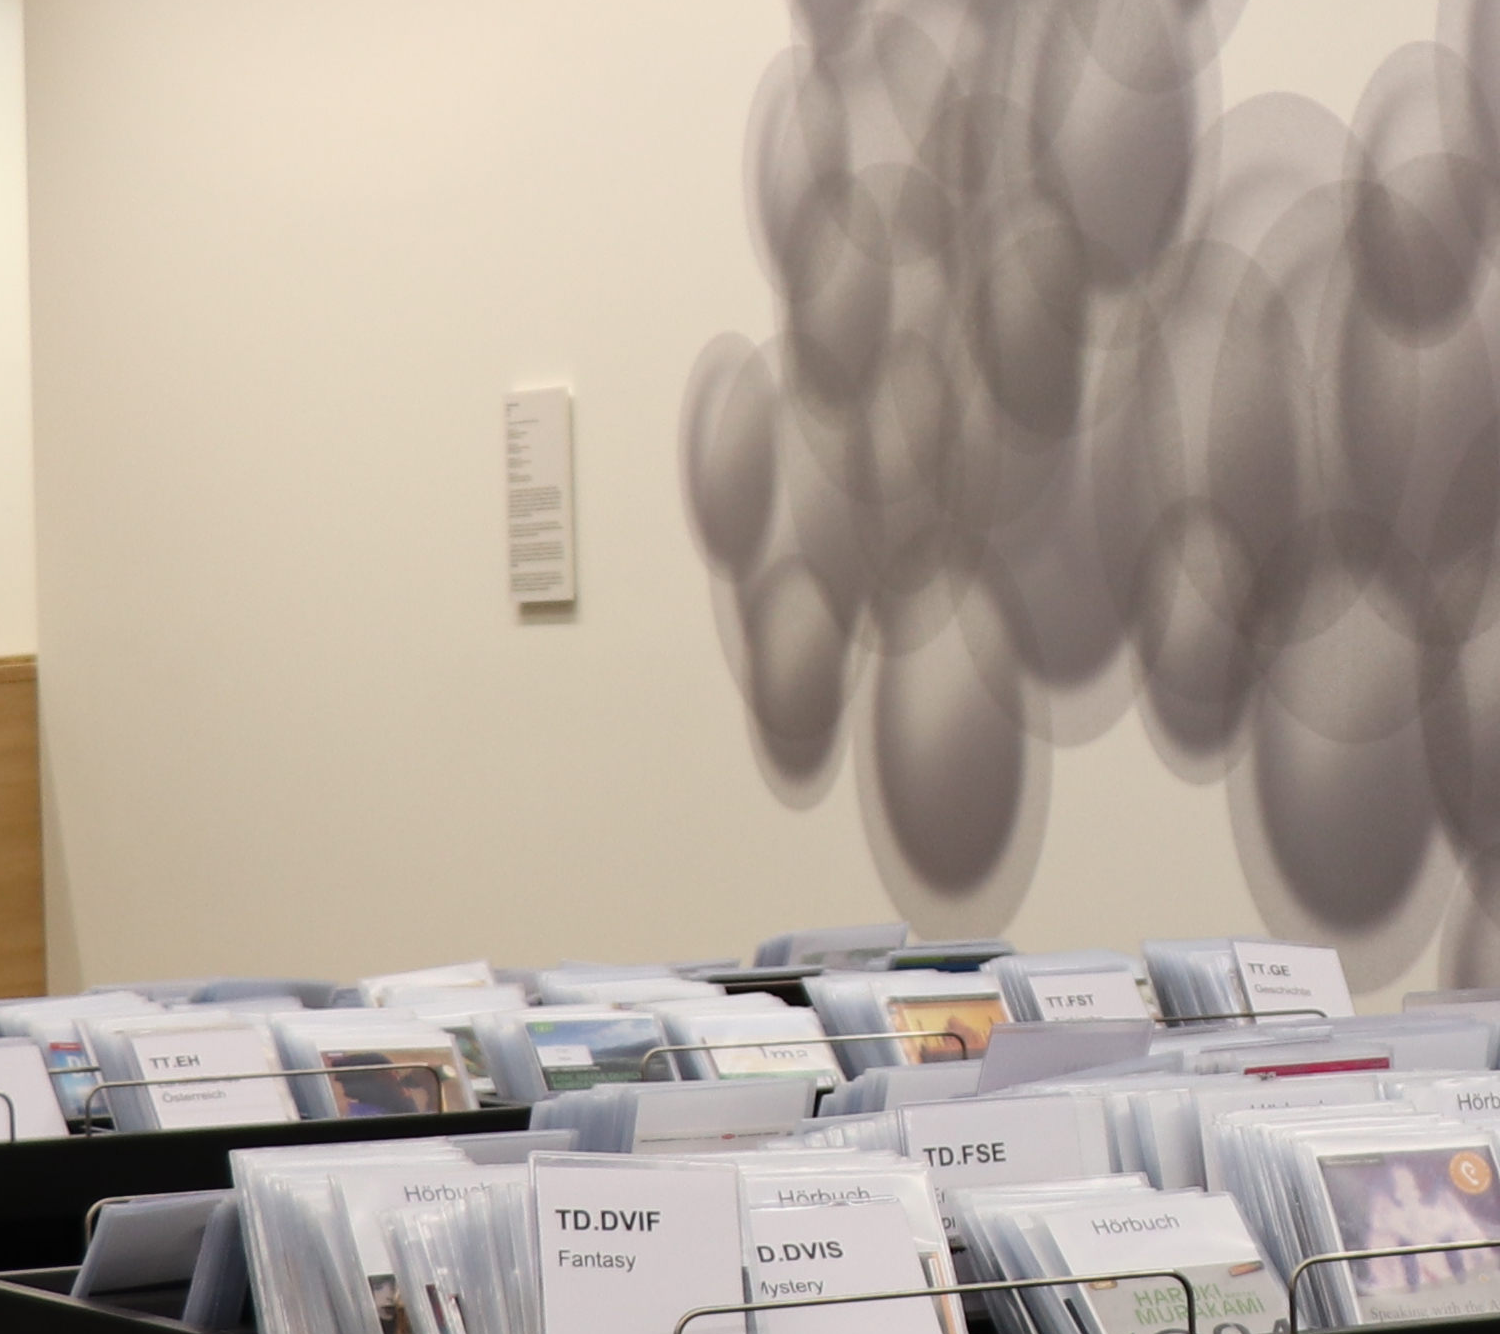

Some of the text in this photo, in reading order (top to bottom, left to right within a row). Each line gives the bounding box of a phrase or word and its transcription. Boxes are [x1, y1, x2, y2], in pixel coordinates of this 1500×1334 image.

[1247, 962, 1292, 977] TT.GE
[1254, 983, 1312, 997] Geschichte
[1045, 993, 1095, 1008] TT.FST
[150, 1054, 201, 1070] TT.EH
[161, 1088, 227, 1104] Österreich
[923, 1142, 1007, 1168] TD.FSE
[555, 1209, 661, 1232] TD.DVIF
[1091, 1213, 1181, 1235] Hörbuch
[558, 1249, 637, 1273] Fantasy
[1431, 1301, 1462, 1316] with
[1464, 1300, 1487, 1314] the
